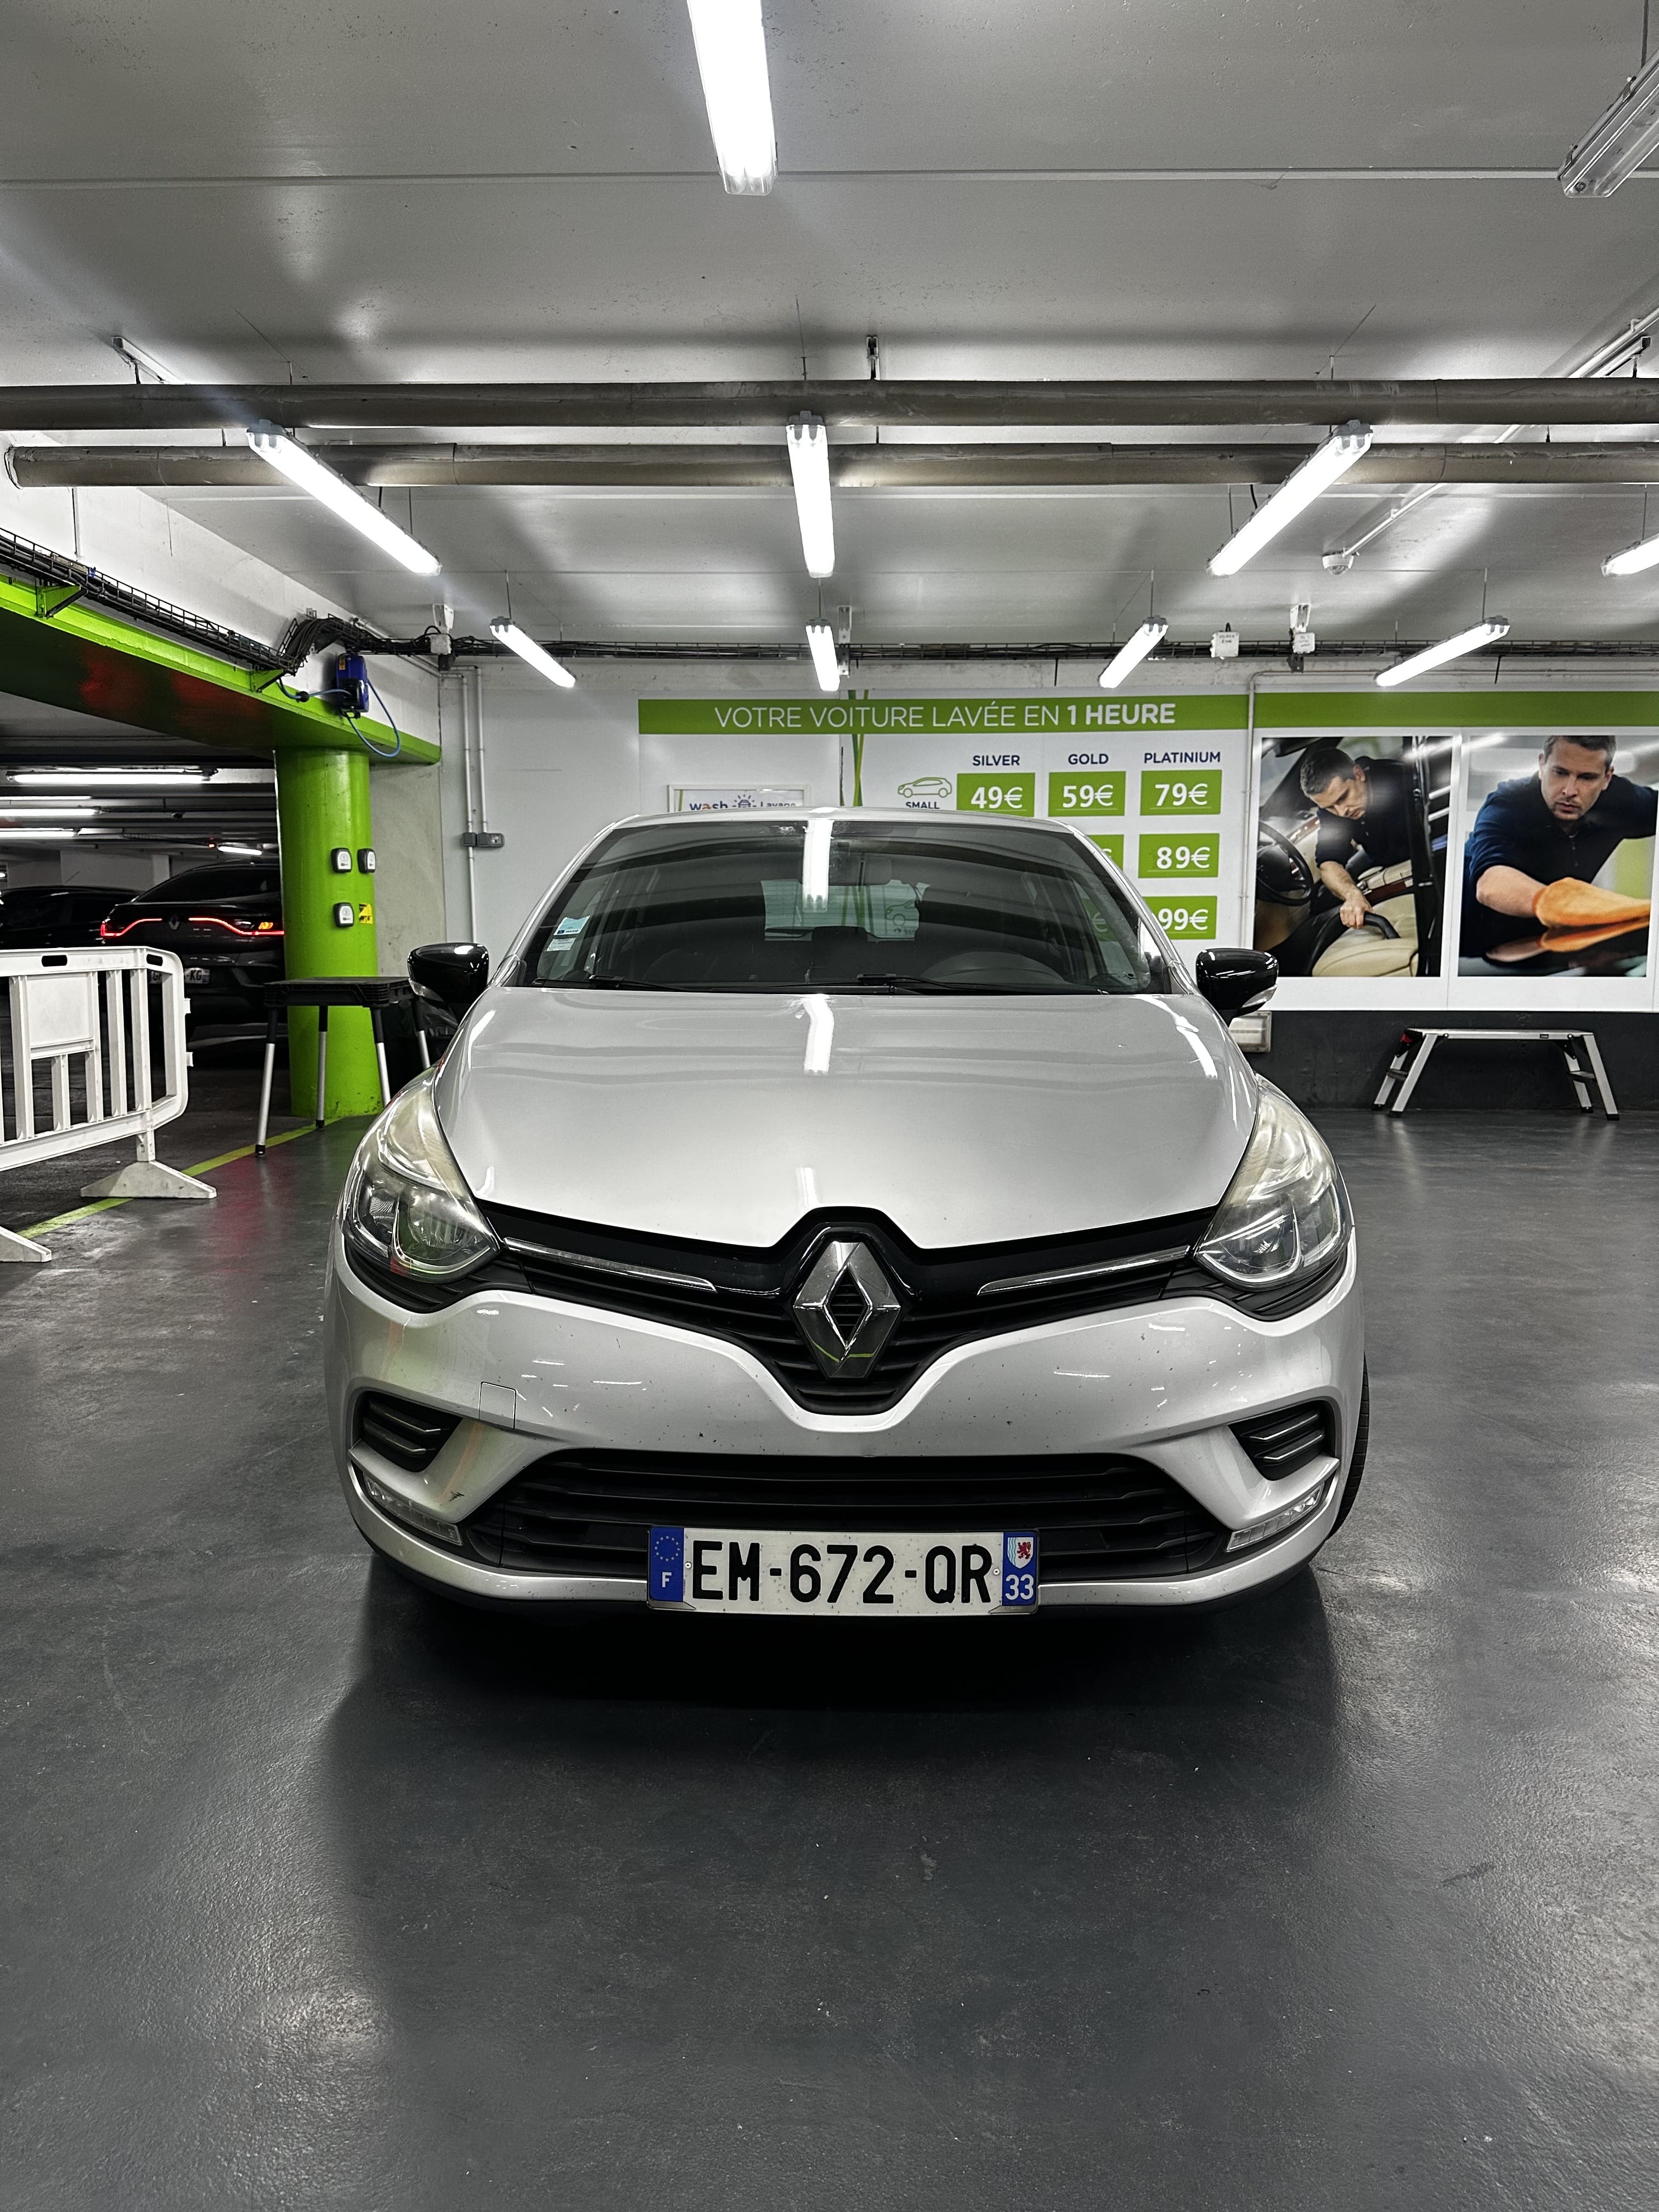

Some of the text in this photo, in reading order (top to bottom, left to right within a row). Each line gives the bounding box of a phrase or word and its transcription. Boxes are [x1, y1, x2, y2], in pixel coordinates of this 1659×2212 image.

[714, 700, 1176, 728] VOTRE VOITURE LAVÉE EN 1 HEURE
[972, 755, 1020, 766] SILVER
[1068, 753, 1109, 765] GOLD
[1144, 751, 1221, 764] PLATINIUM
[689, 800, 728, 810] wash
[906, 801, 940, 809] SMALL
[970, 786, 1023, 809] 49€
[1062, 784, 1114, 808] 59€
[1155, 782, 1208, 806] 79€
[1156, 845, 1210, 869] 89€
[1158, 908, 1209, 930] 99€
[662, 1541, 1034, 1604] F EM-672-QR 33
